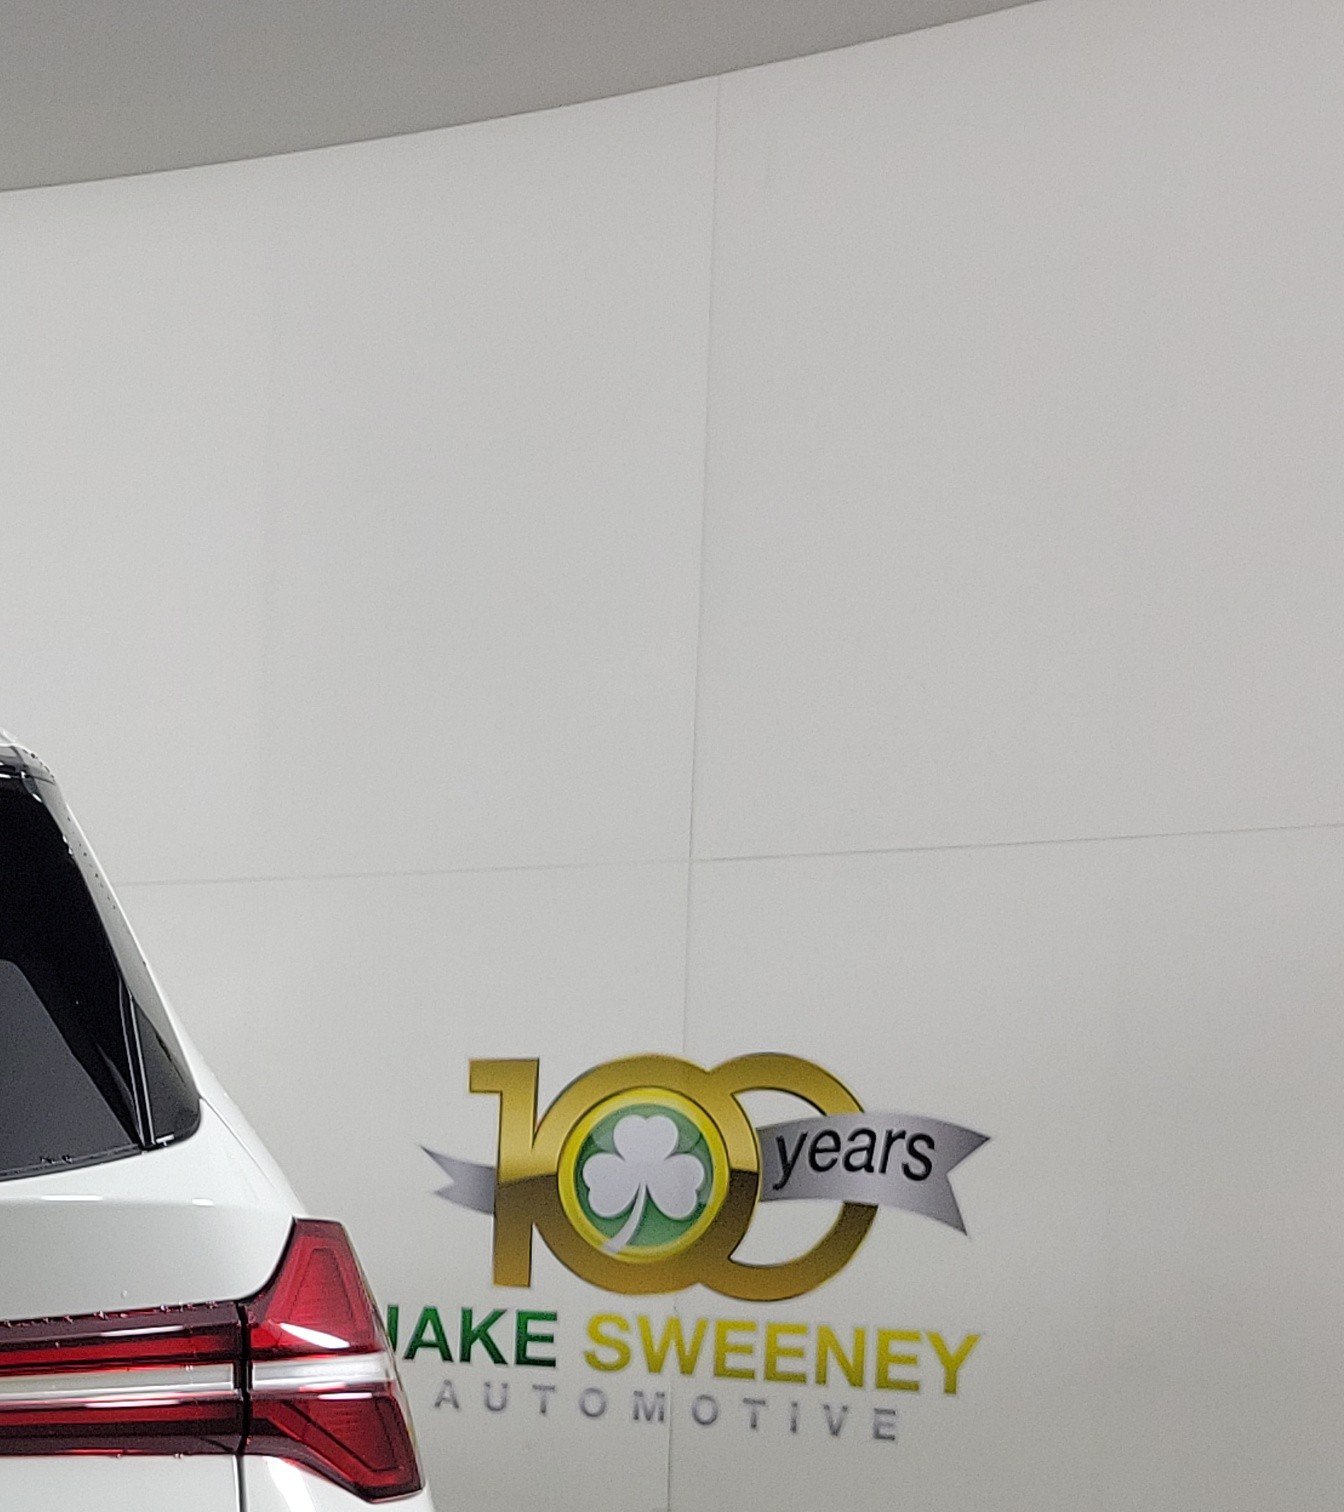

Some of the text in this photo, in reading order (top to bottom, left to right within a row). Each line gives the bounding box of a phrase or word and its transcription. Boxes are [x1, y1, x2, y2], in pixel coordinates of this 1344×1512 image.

[469, 1052, 938, 1302] 100 years
[583, 1311, 982, 1396] SWEENEY
[433, 1379, 900, 1442] AUTOMOTIVE
